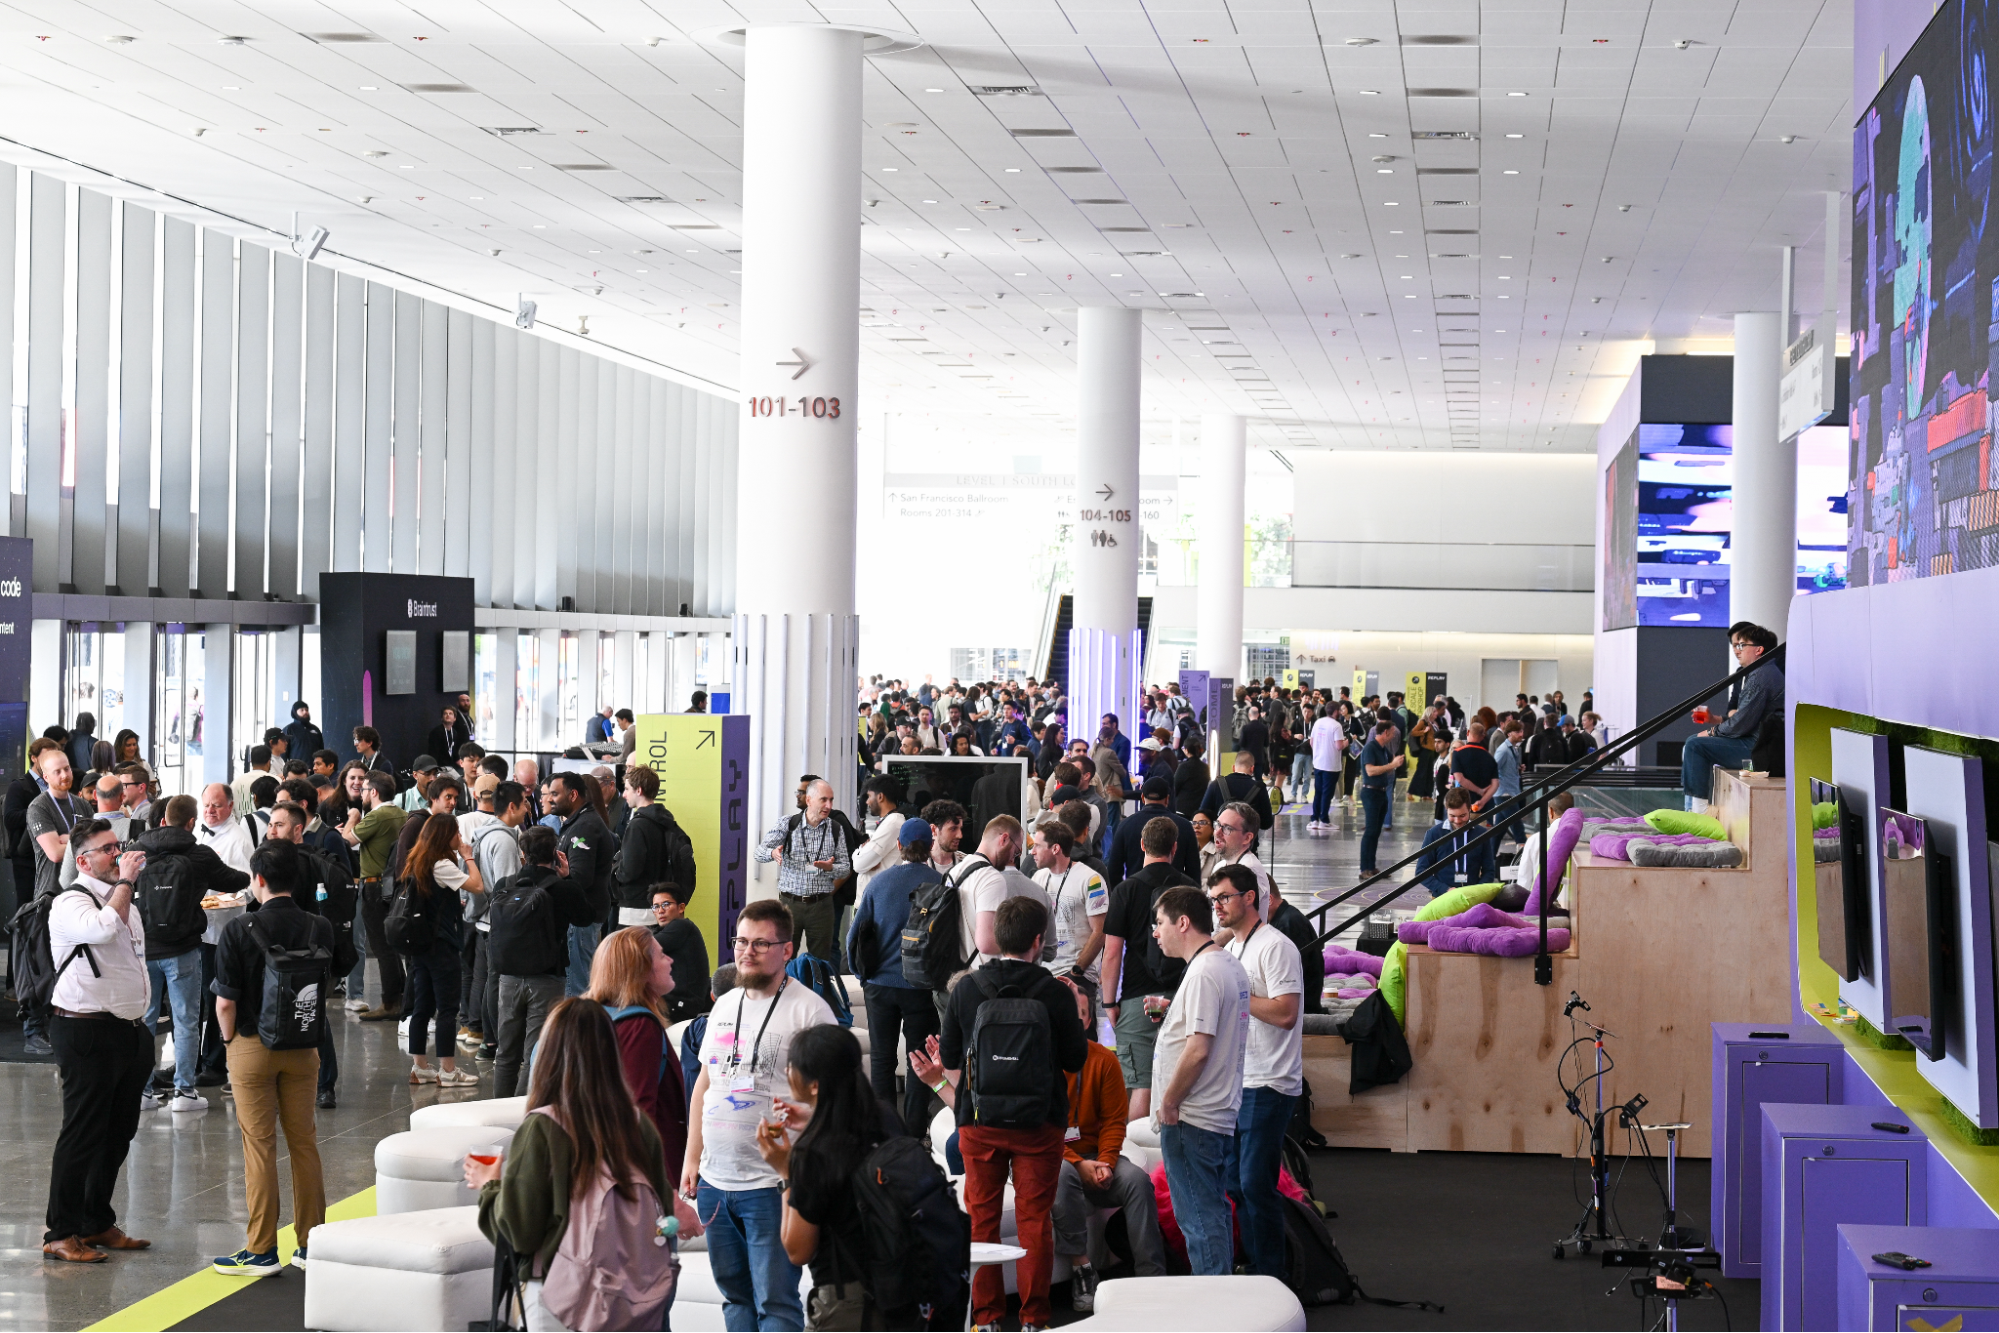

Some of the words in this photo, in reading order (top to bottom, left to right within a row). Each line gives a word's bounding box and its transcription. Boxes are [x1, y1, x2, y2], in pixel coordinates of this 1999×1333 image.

[748, 396, 841, 418] 101-103
[956, 475, 995, 486] LEVEL
[1012, 476, 1057, 486] SOUTH
[900, 493, 918, 503] San
[920, 493, 964, 503] Francisco
[967, 494, 1009, 503] Ballroom
[900, 508, 932, 517] Rooms
[935, 508, 972, 518] 201-314
[1080, 509, 1132, 522] 104-105
[0, 576, 21, 598] code
[0, 622, 14, 635] ntent
[1310, 655, 1326, 663] Taxi
[1210, 683, 1218, 730] COME
